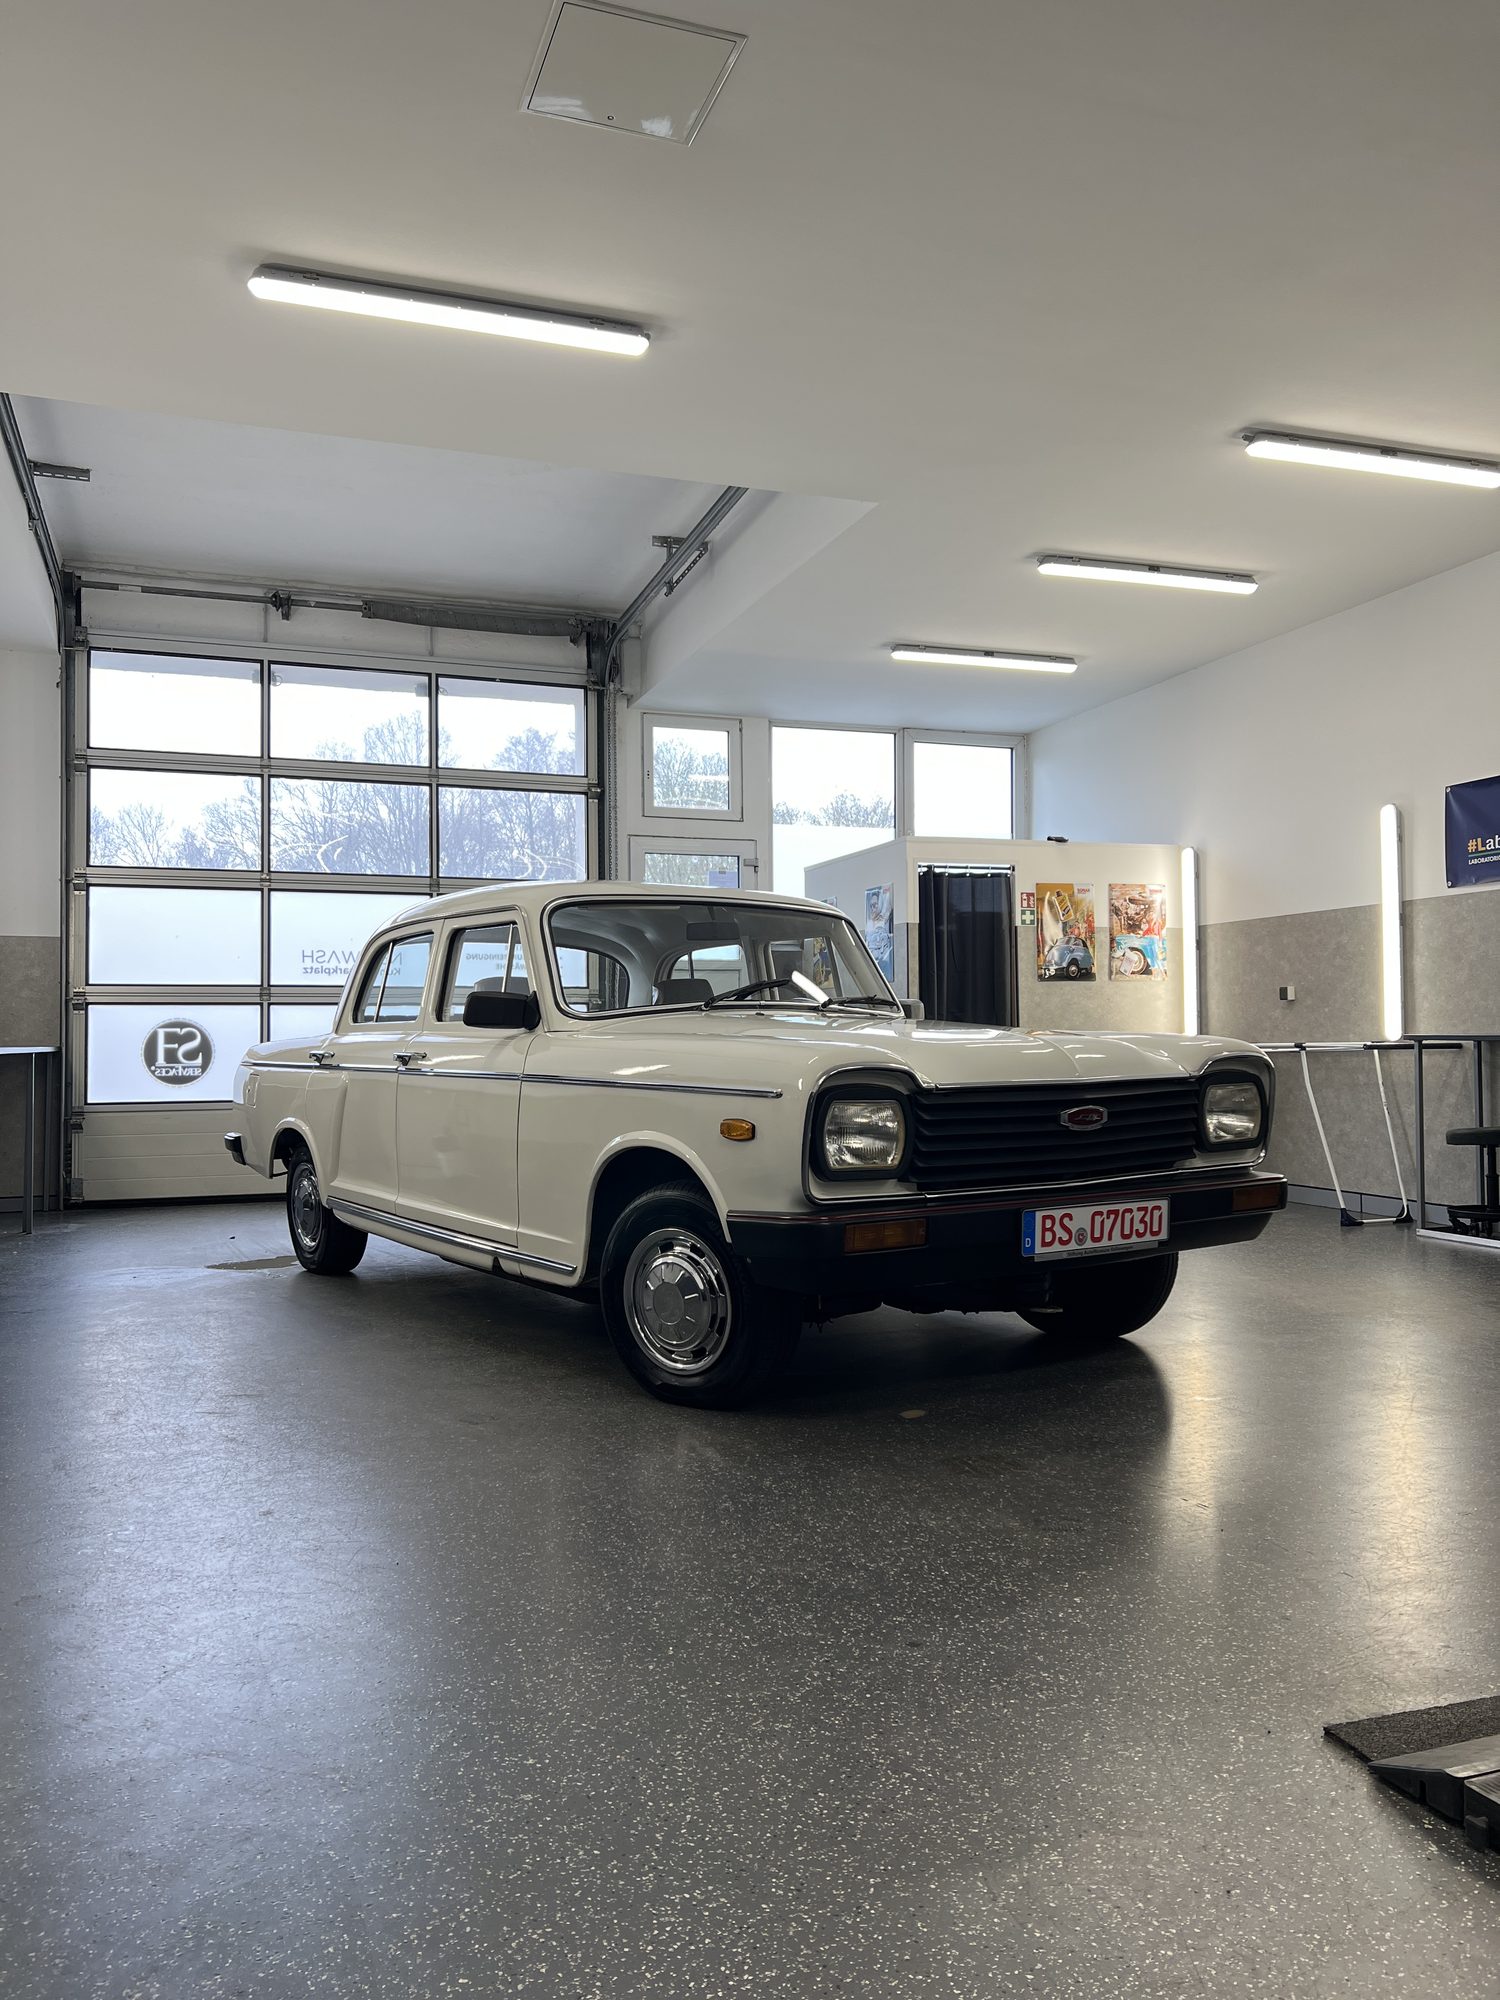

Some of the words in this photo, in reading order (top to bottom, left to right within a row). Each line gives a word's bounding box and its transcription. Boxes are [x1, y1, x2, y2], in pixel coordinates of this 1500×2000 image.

[1041, 1212, 1074, 1248] BS
[1090, 1205, 1163, 1244] 07030
[1025, 1237, 1032, 1248] D
